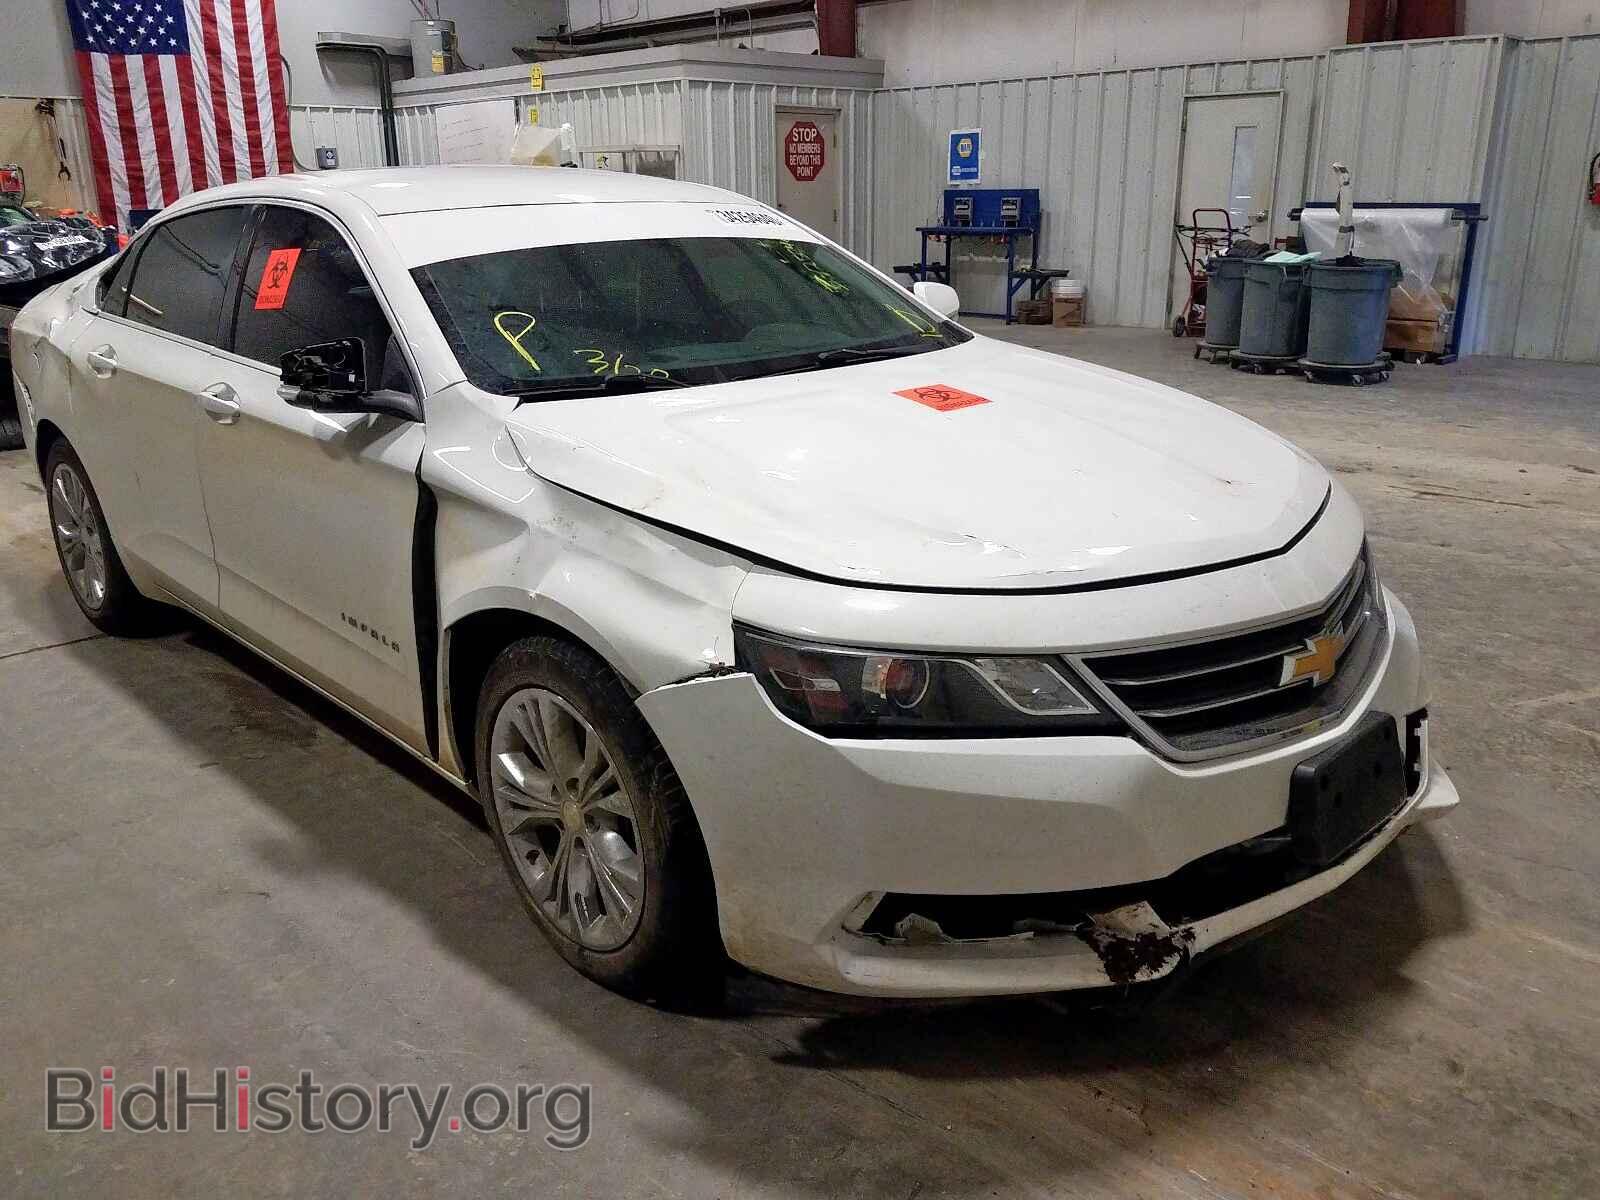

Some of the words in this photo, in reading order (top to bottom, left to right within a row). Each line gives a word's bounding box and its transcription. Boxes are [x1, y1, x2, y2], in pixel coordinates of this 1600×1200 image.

[792, 128, 817, 142] STOP
[789, 144, 797, 153] NO
[798, 144, 821, 153] MEMBERS
[789, 154, 810, 166] BEYOND
[810, 154, 821, 165] THIS
[796, 166, 814, 177] POINT
[340, 612, 400, 654] IMPALA
